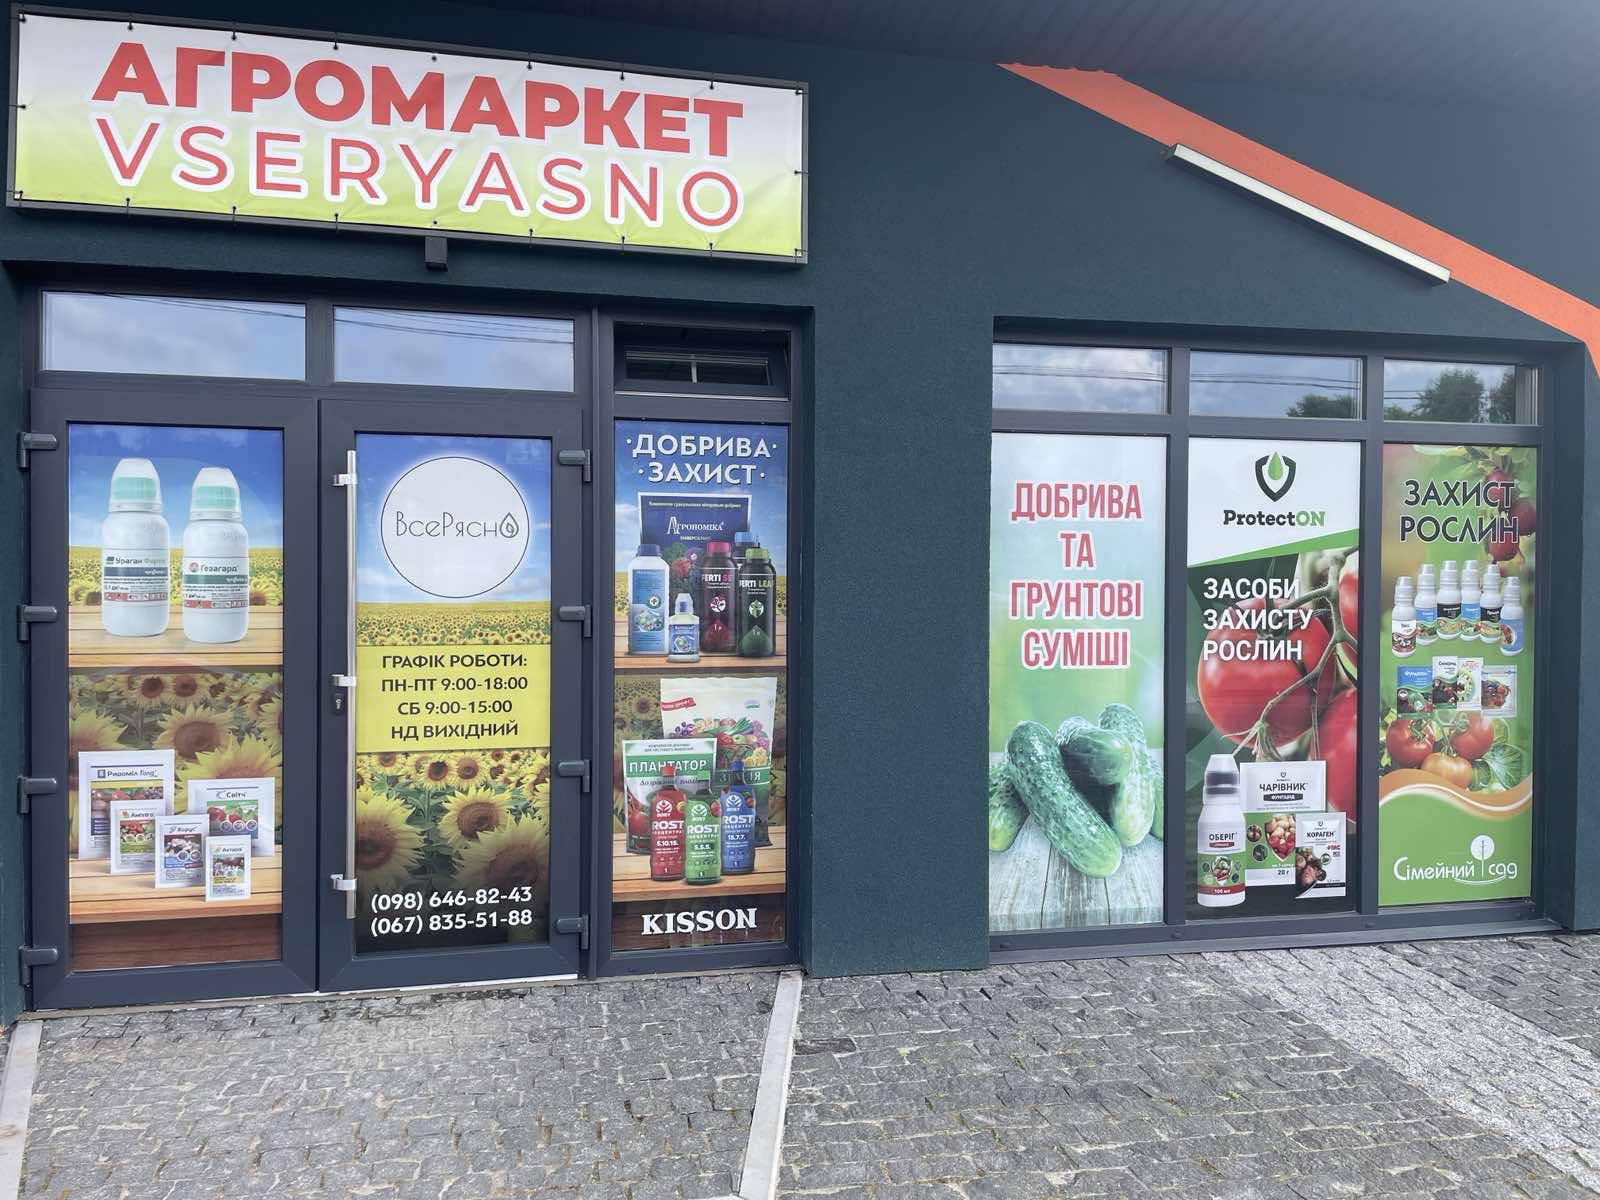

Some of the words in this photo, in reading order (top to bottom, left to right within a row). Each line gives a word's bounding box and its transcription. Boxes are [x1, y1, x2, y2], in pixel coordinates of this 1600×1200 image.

[92, 41, 744, 157] АГРОМАРКЕТ
[94, 117, 740, 227] VSERYASNO
[1011, 482, 1142, 521] ДОБРИВА
[1404, 479, 1515, 507] ЗАХИСТ
[1223, 509, 1326, 527] ProtectON
[1400, 516, 1519, 543] РОСЛИН
[1060, 533, 1094, 568] ТА
[1011, 582, 1141, 617] ГРУНТОВІ
[1203, 578, 1300, 599] ЗАСОБИ
[1203, 608, 1313, 630] ЗАХИСТУ
[1024, 631, 1128, 666] СУМІШІ
[1203, 640, 1302, 661] РОСЛИН
[382, 654, 445, 668] ГРАФІК
[450, 654, 527, 668] РОБОТИ:
[381, 679, 437, 692] ПН-ПТ
[441, 676, 528, 691] 9:00-18:00
[397, 702, 420, 715] СБ
[425, 700, 512, 715] 9:00-15:00
[391, 725, 418, 741] НД
[423, 719, 518, 739] ВИХІДНИЙ
[629, 759, 707, 773] ПЛАНТАТОР
[1259, 782, 1306, 792] ЧАРІВНИК
[652, 820, 685, 830] ROST
[687, 824, 720, 834] ROST
[722, 814, 754, 824] ROST
[1393, 857, 1475, 881] Сімейний
[1488, 862, 1518, 879] сад
[371, 891, 423, 913] (098)
[429, 886, 532, 908] 646-82-43
[371, 915, 423, 937] (067)
[429, 909, 532, 931] 835-51-88
[641, 908, 758, 936] KISSON
